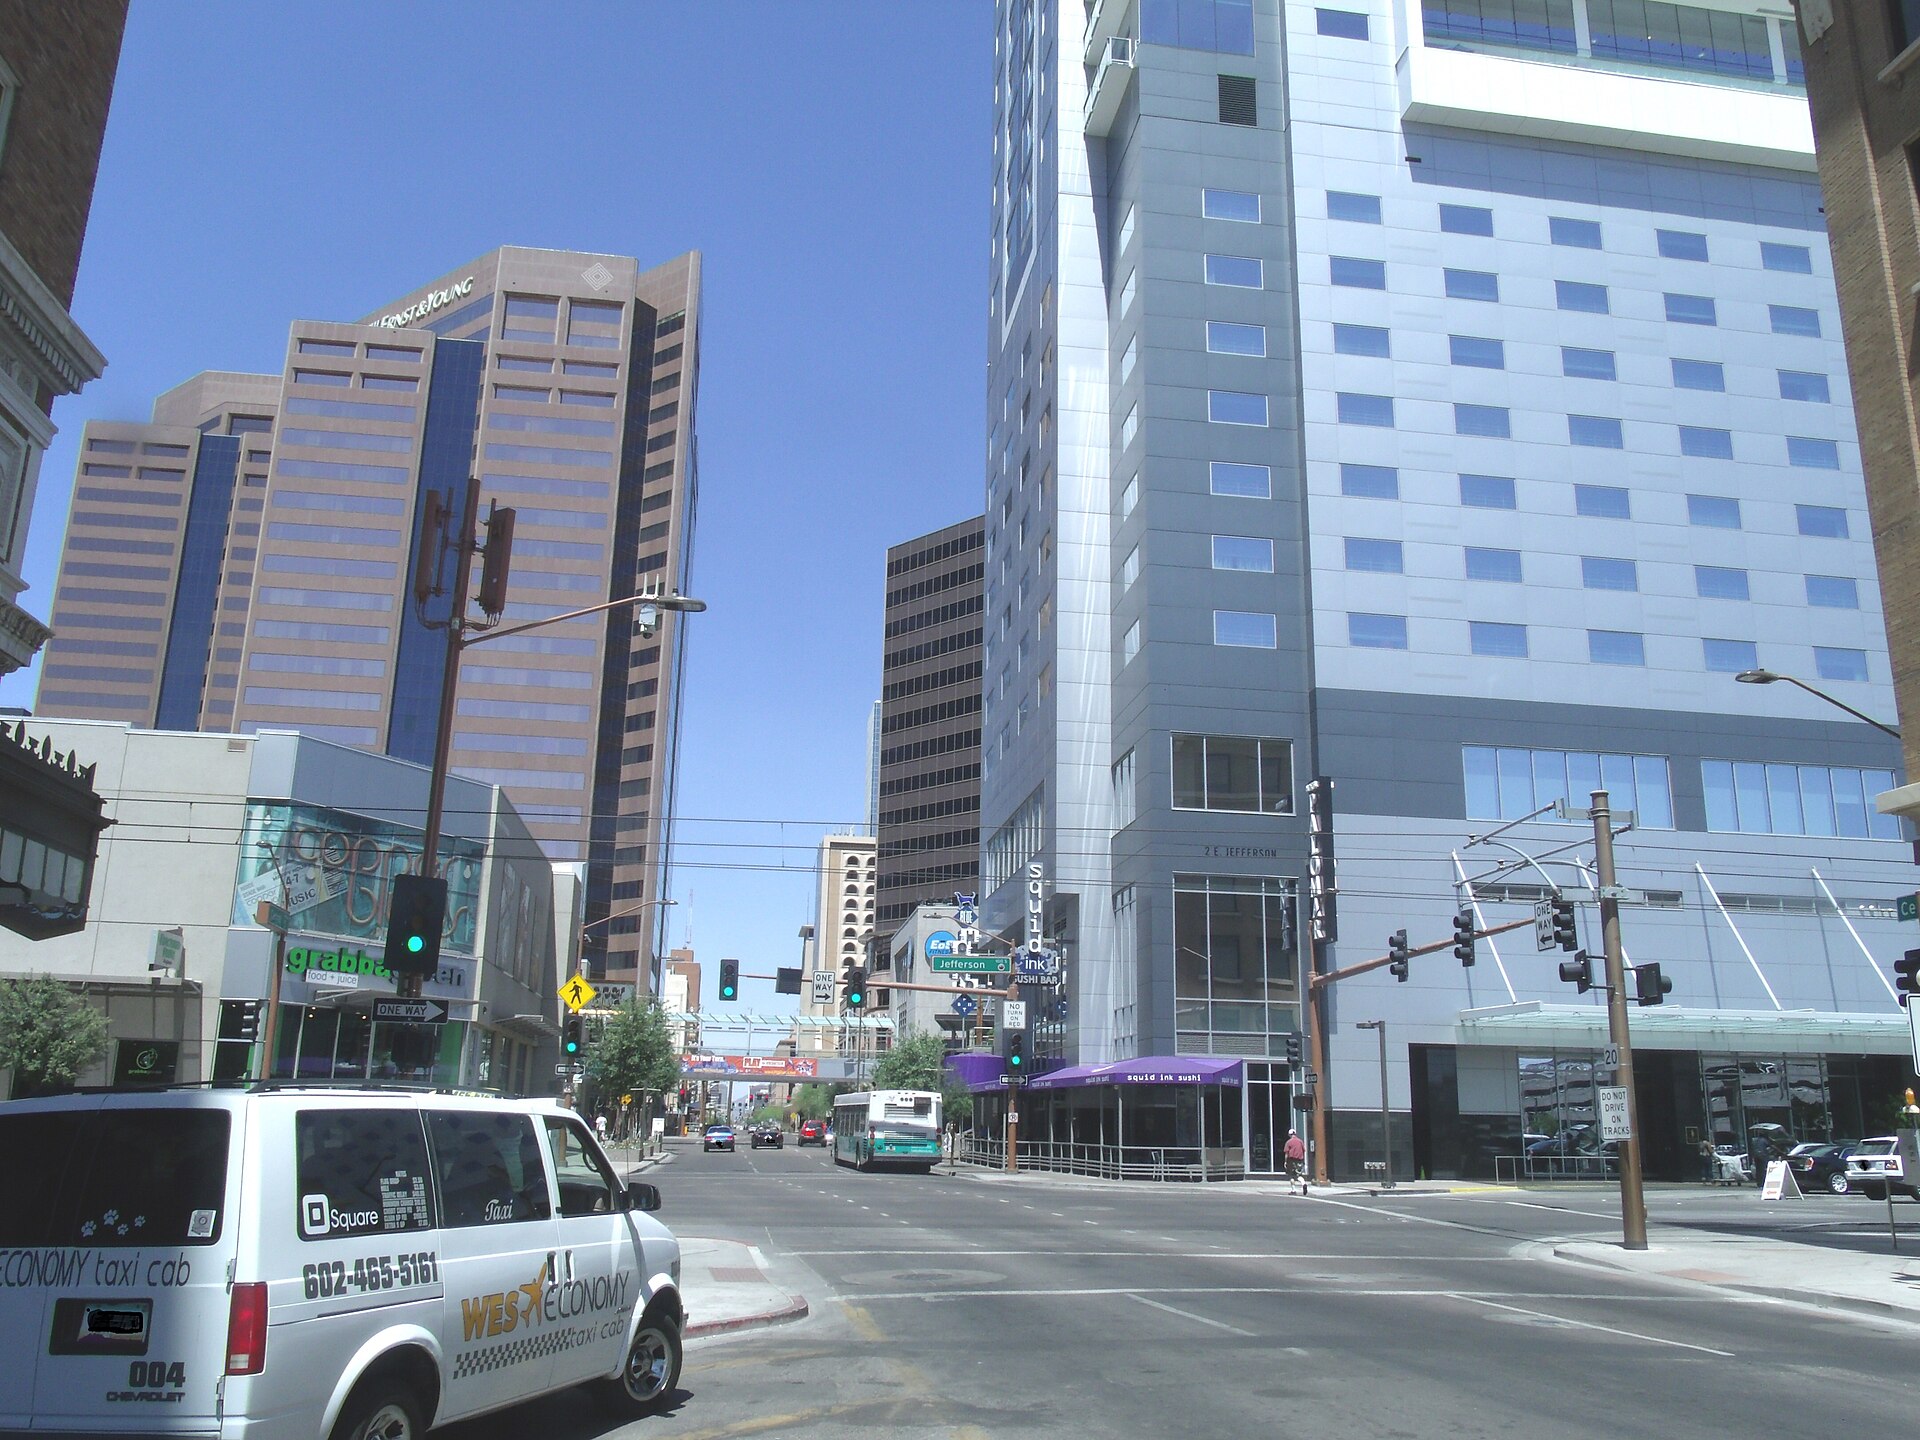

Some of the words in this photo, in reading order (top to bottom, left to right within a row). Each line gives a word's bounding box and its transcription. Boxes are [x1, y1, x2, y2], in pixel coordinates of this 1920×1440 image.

[1204, 846, 1210, 856] 2
[1028, 864, 1042, 953] squid
[1537, 904, 1551, 917] ONE
[1537, 918, 1552, 931] WAY
[940, 960, 985, 969] Jefferson
[1025, 956, 1045, 970] ink
[307, 970, 327, 981] food
[336, 973, 357, 985] juice
[815, 974, 832, 982] ONE
[1040, 976, 1058, 985] BAR
[815, 983, 832, 991] WAY
[379, 1005, 400, 1015] ONE
[405, 1006, 427, 1016] WAY
[1605, 1049, 1617, 1065] 20
[1127, 1074, 1155, 1082] squid
[1160, 1073, 1173, 1081] ink
[1178, 1074, 1201, 1082] sushi
[1602, 1092, 1611, 1101] DO
[1613, 1091, 1626, 1100] NOT
[1605, 1103, 1625, 1112] DRIVE
[1611, 1115, 1621, 1123] ON
[1604, 1126, 1630, 1135] TRACKS
[484, 1198, 514, 1222] Taxi
[331, 1208, 379, 1232] Square
[95, 1252, 140, 1287] taxi
[147, 1251, 191, 1287] cab
[302, 1251, 439, 1300] 602-465-5161
[570, 1320, 598, 1349] taxi
[601, 1314, 624, 1338] cab
[128, 1360, 186, 1388] 004
[106, 1391, 186, 1403] CHEVROLET
